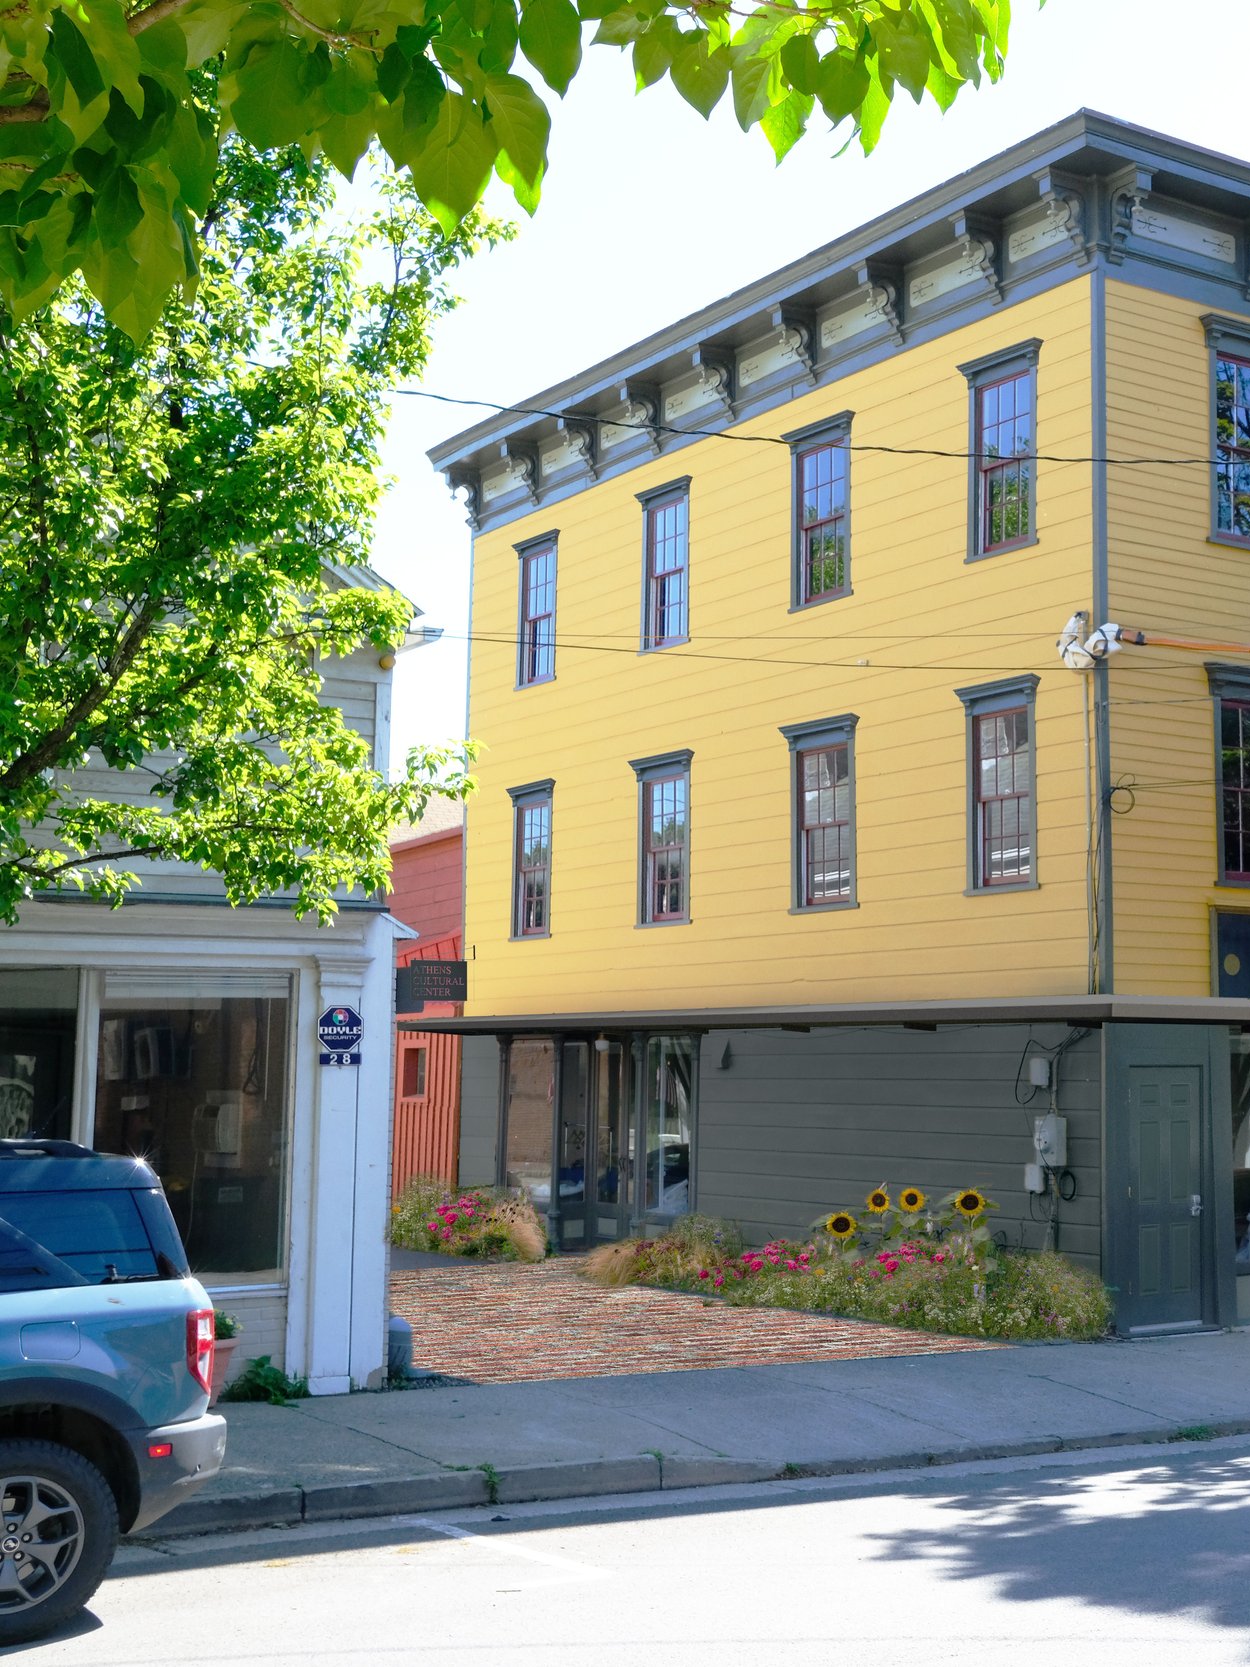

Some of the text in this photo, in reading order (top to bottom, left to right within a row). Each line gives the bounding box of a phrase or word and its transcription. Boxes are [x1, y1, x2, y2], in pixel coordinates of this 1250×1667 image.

[413, 965, 452, 975] ATHENS
[413, 977, 465, 986] CULTURAL
[413, 987, 452, 997] CENTER
[320, 1026, 362, 1035] DOYLE
